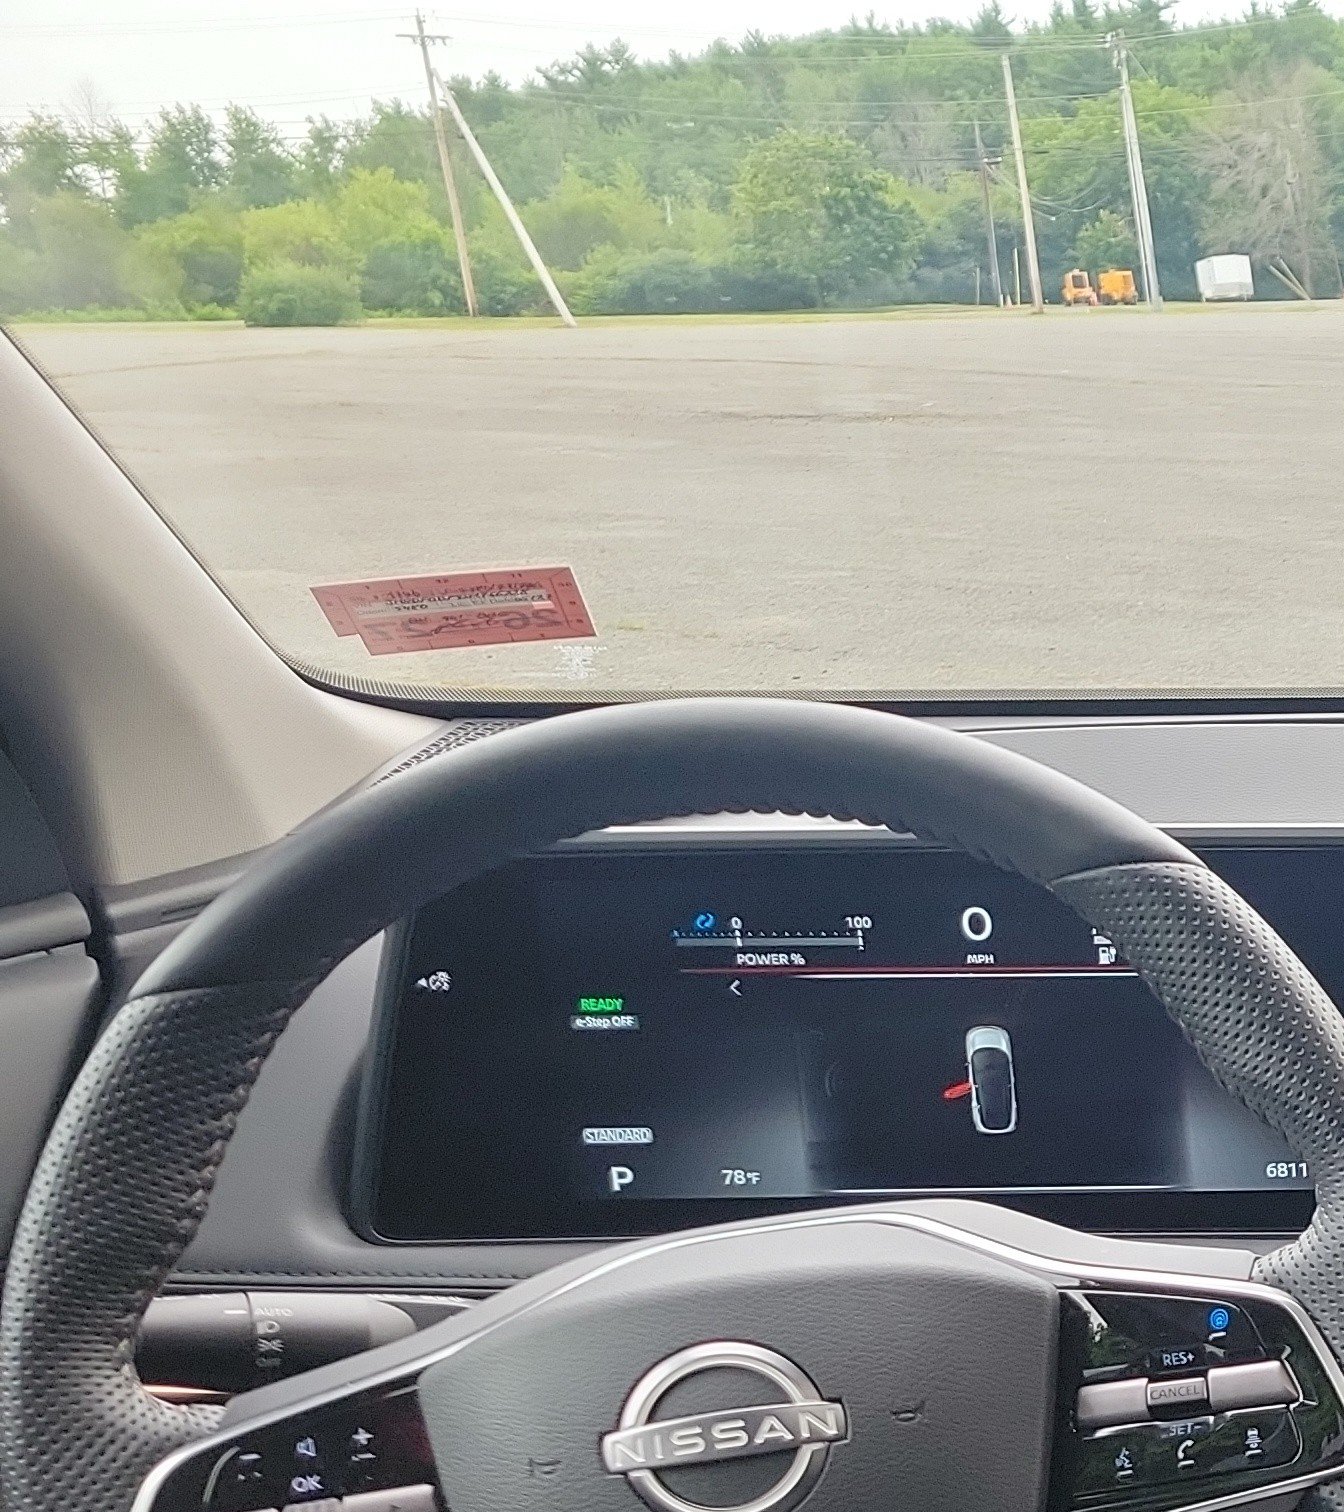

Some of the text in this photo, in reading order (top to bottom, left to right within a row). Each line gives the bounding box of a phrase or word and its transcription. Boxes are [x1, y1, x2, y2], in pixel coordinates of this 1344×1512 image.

[730, 916, 742, 929] 0
[845, 916, 873, 929] 100
[962, 906, 993, 941] 0
[736, 953, 806, 966] POWER %
[966, 953, 995, 964] MPH
[580, 998, 623, 1012] READY
[611, 1016, 635, 1027] OFF
[585, 1129, 650, 1142] STANDARD
[610, 1166, 634, 1191] P
[1163, 1351, 1195, 1366] RES+
[1150, 1384, 1201, 1400] CANCEL
[612, 1408, 841, 1468] NISSAN
[291, 1475, 325, 1493] OK
